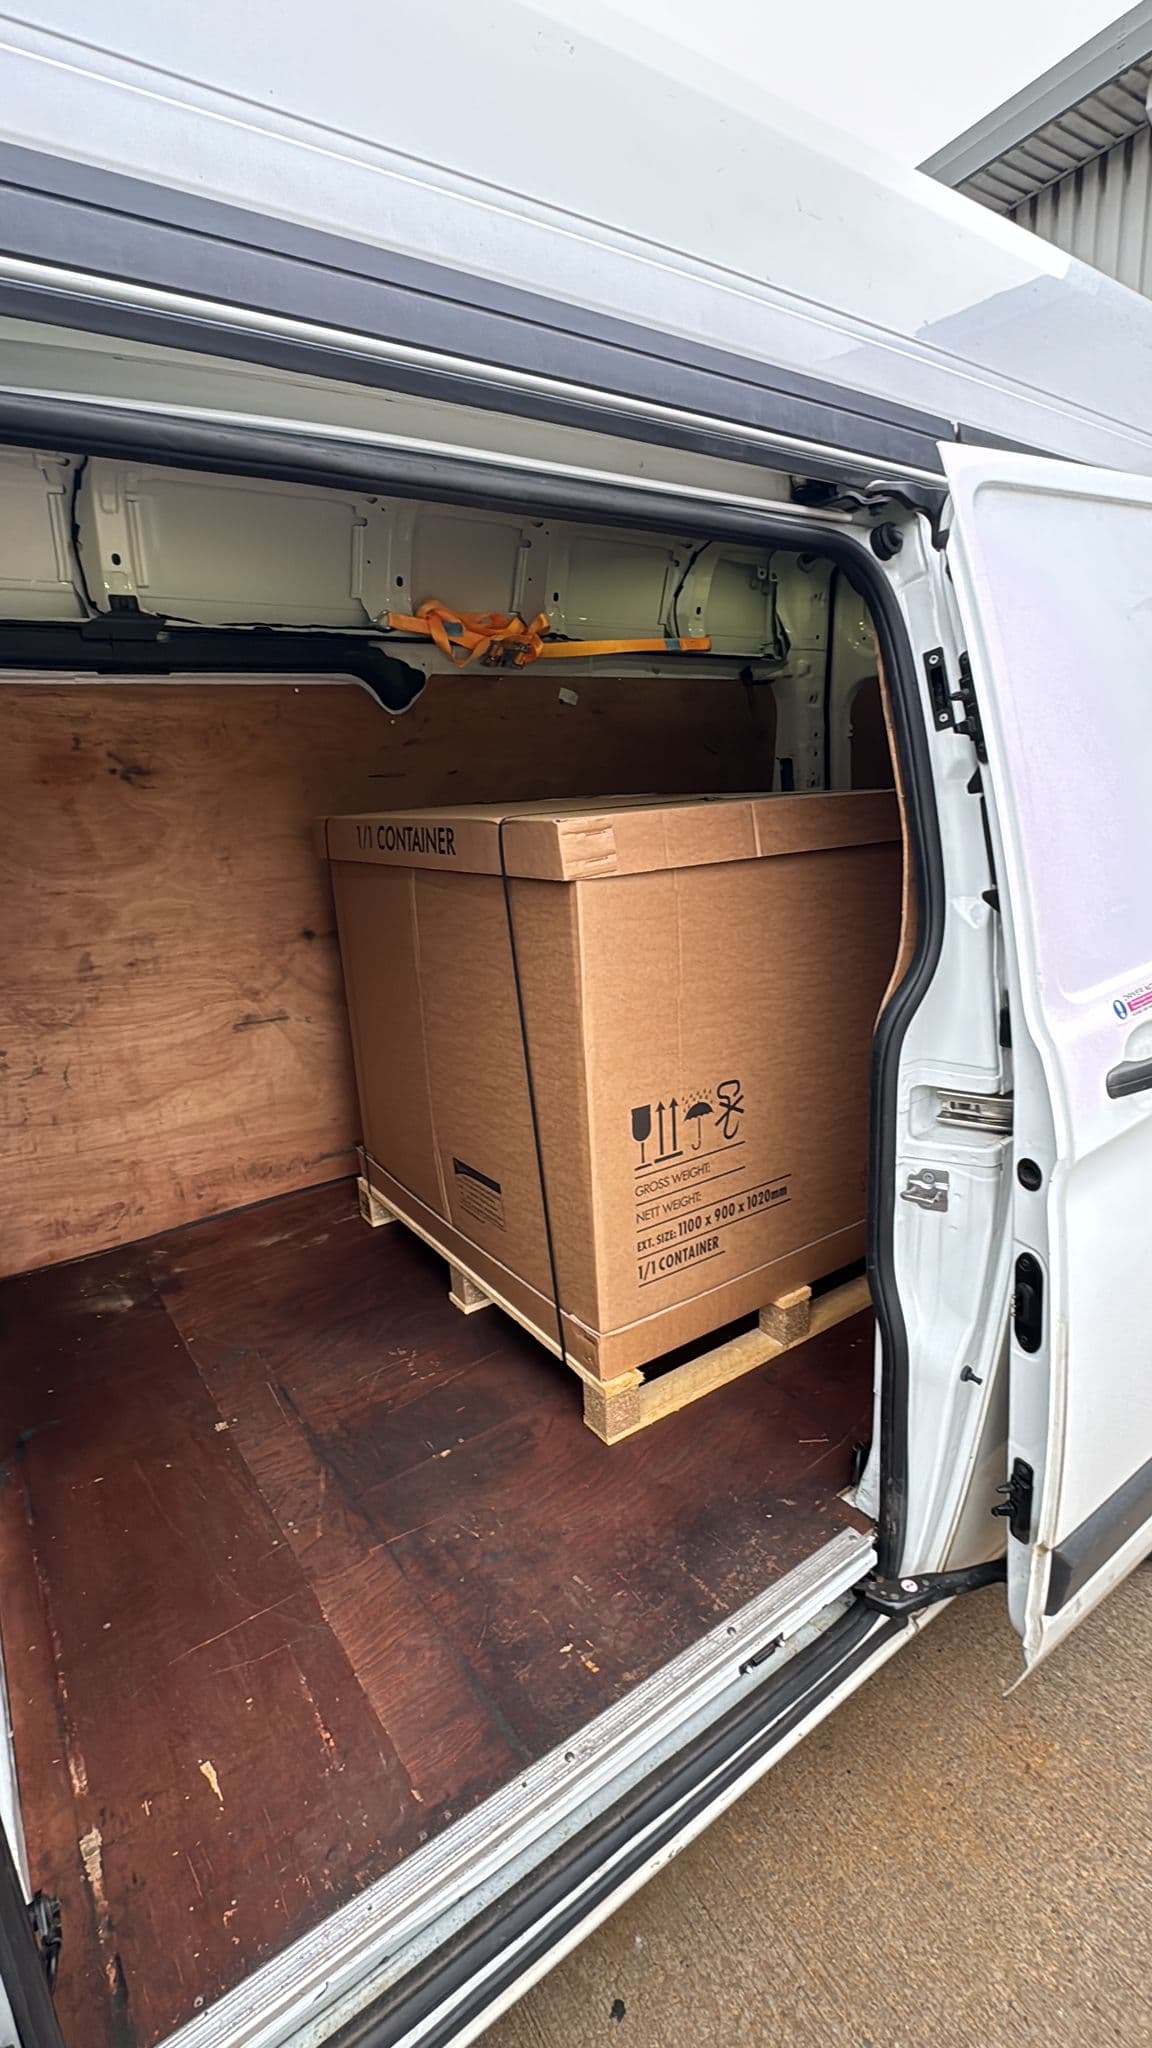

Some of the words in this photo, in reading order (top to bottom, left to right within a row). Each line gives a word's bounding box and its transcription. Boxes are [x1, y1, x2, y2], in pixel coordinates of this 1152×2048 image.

[356, 826, 372, 849] 1/1
[377, 826, 456, 855] CONTAINER
[635, 1175, 670, 1197] GROSS
[672, 1163, 711, 1183] WEIGHT:
[637, 1234, 656, 1252] EXT.
[656, 1226, 677, 1245] SIZE:
[678, 1216, 702, 1236] 1100
[705, 1216, 712, 1226] x
[714, 1203, 736, 1222] 900
[738, 1203, 745, 1212] x
[747, 1186, 788, 1210] 1020mm
[662, 1191, 702, 1213] WEIGHT:
[638, 1261, 656, 1280] 1/1
[659, 1236, 720, 1271] CONTAINER
